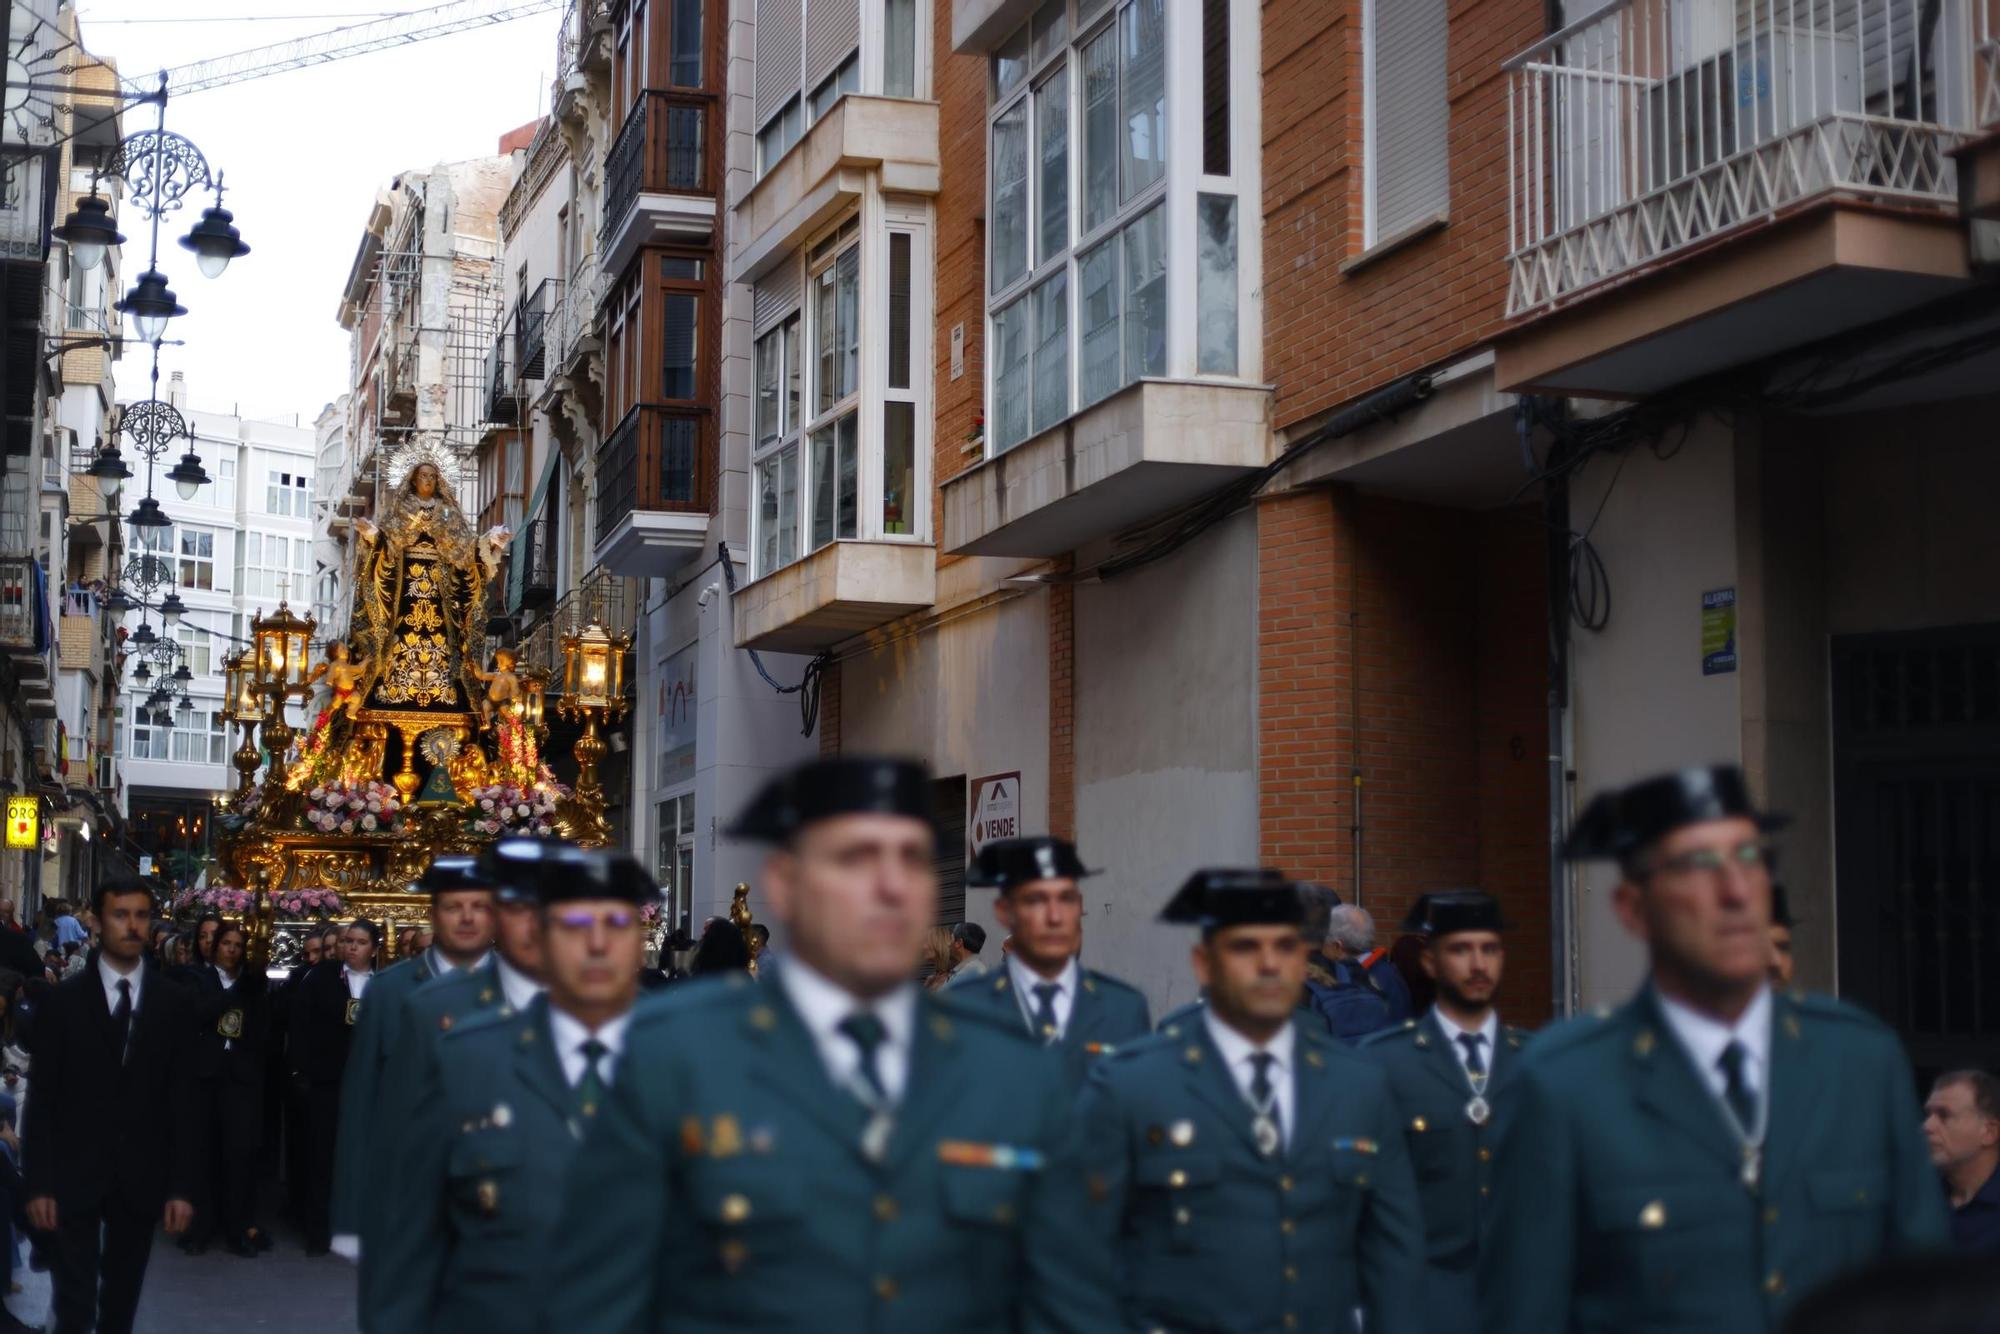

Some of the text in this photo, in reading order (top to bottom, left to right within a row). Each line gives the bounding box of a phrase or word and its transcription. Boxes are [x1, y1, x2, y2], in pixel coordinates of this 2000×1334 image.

[8, 798, 38, 806] COMPRO
[8, 807, 38, 819] ORO
[985, 817, 1014, 839] VENDE
